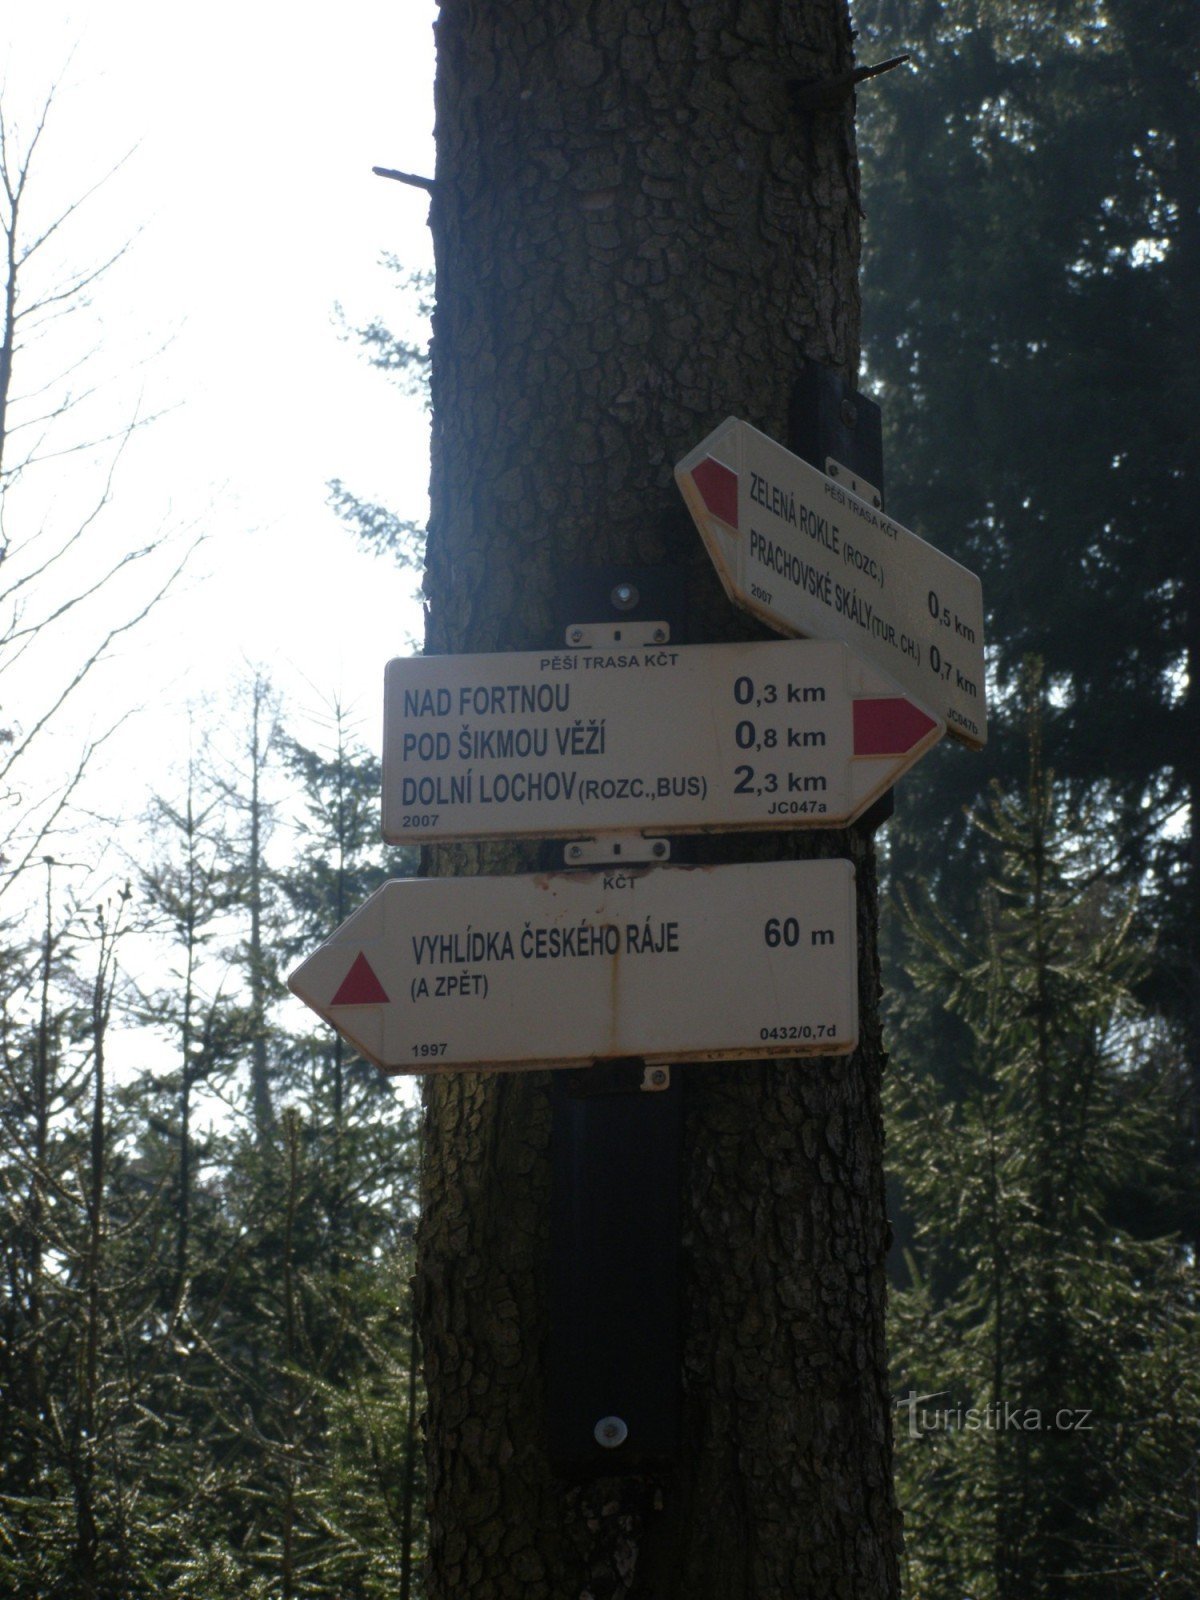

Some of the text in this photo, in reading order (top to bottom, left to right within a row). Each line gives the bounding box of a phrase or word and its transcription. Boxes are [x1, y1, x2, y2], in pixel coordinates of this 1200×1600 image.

[847, 497, 879, 529] TRASA
[879, 519, 898, 541] KČT
[750, 471, 976, 644] ZELENÁ ROKLE (ROZC.) 0,5 km
[751, 583, 772, 606] 2007
[750, 529, 833, 607] PRACHOVSKÉ
[901, 633, 921, 667] CH.)
[929, 645, 953, 681] 0,7
[956, 669, 977, 699] km
[540, 651, 680, 671] PĚŠÍ TRASA KČT
[403, 676, 826, 718] NAD FORTNOU 0,3 km
[947, 707, 979, 736] JC047b
[403, 718, 826, 762] POD ŠIKMOU VĚŽÍ 0,8 km
[402, 768, 473, 806] DOLNÍ
[733, 765, 778, 797] 2,3
[787, 772, 827, 792] km
[402, 814, 439, 828] 2007
[767, 801, 827, 815] JC047a
[603, 873, 637, 890] KČT
[412, 915, 835, 965] VYHLÍDKA ČESKÉHO RÁJE 60 m
[410, 970, 489, 1003] (A ZPĚT)
[759, 1024, 837, 1041] 0432/0,7d
[411, 1043, 448, 1057] 1997
